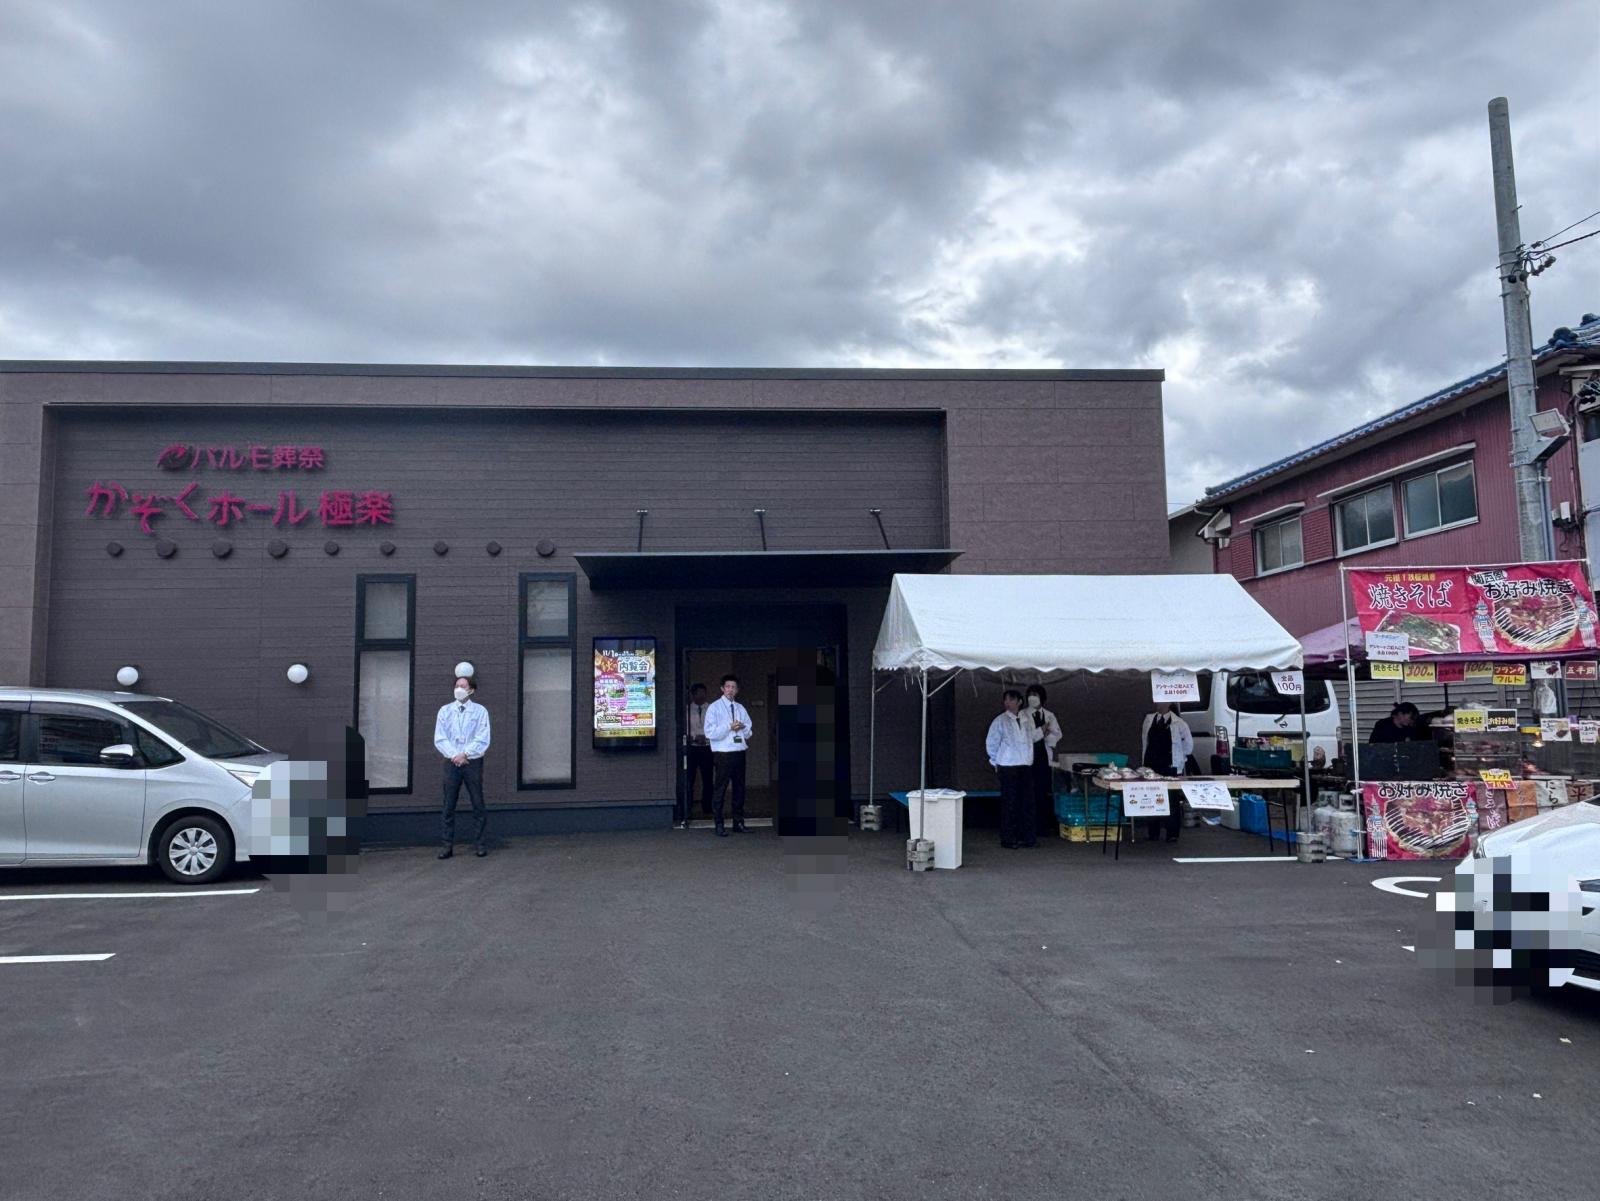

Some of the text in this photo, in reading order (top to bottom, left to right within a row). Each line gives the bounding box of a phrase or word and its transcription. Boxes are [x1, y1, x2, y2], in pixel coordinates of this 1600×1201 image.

[1483, 579, 1578, 600] お好み焼き
[1368, 580, 1453, 610] 焼きそば
[619, 660, 649, 672] 内覧会
[1373, 664, 1400, 672] 焼きそば
[1494, 665, 1525, 674] フランク
[1277, 682, 1302, 691] 100円
[1457, 716, 1482, 725] 焼きそば
[1378, 782, 1468, 798] お好み焼き
